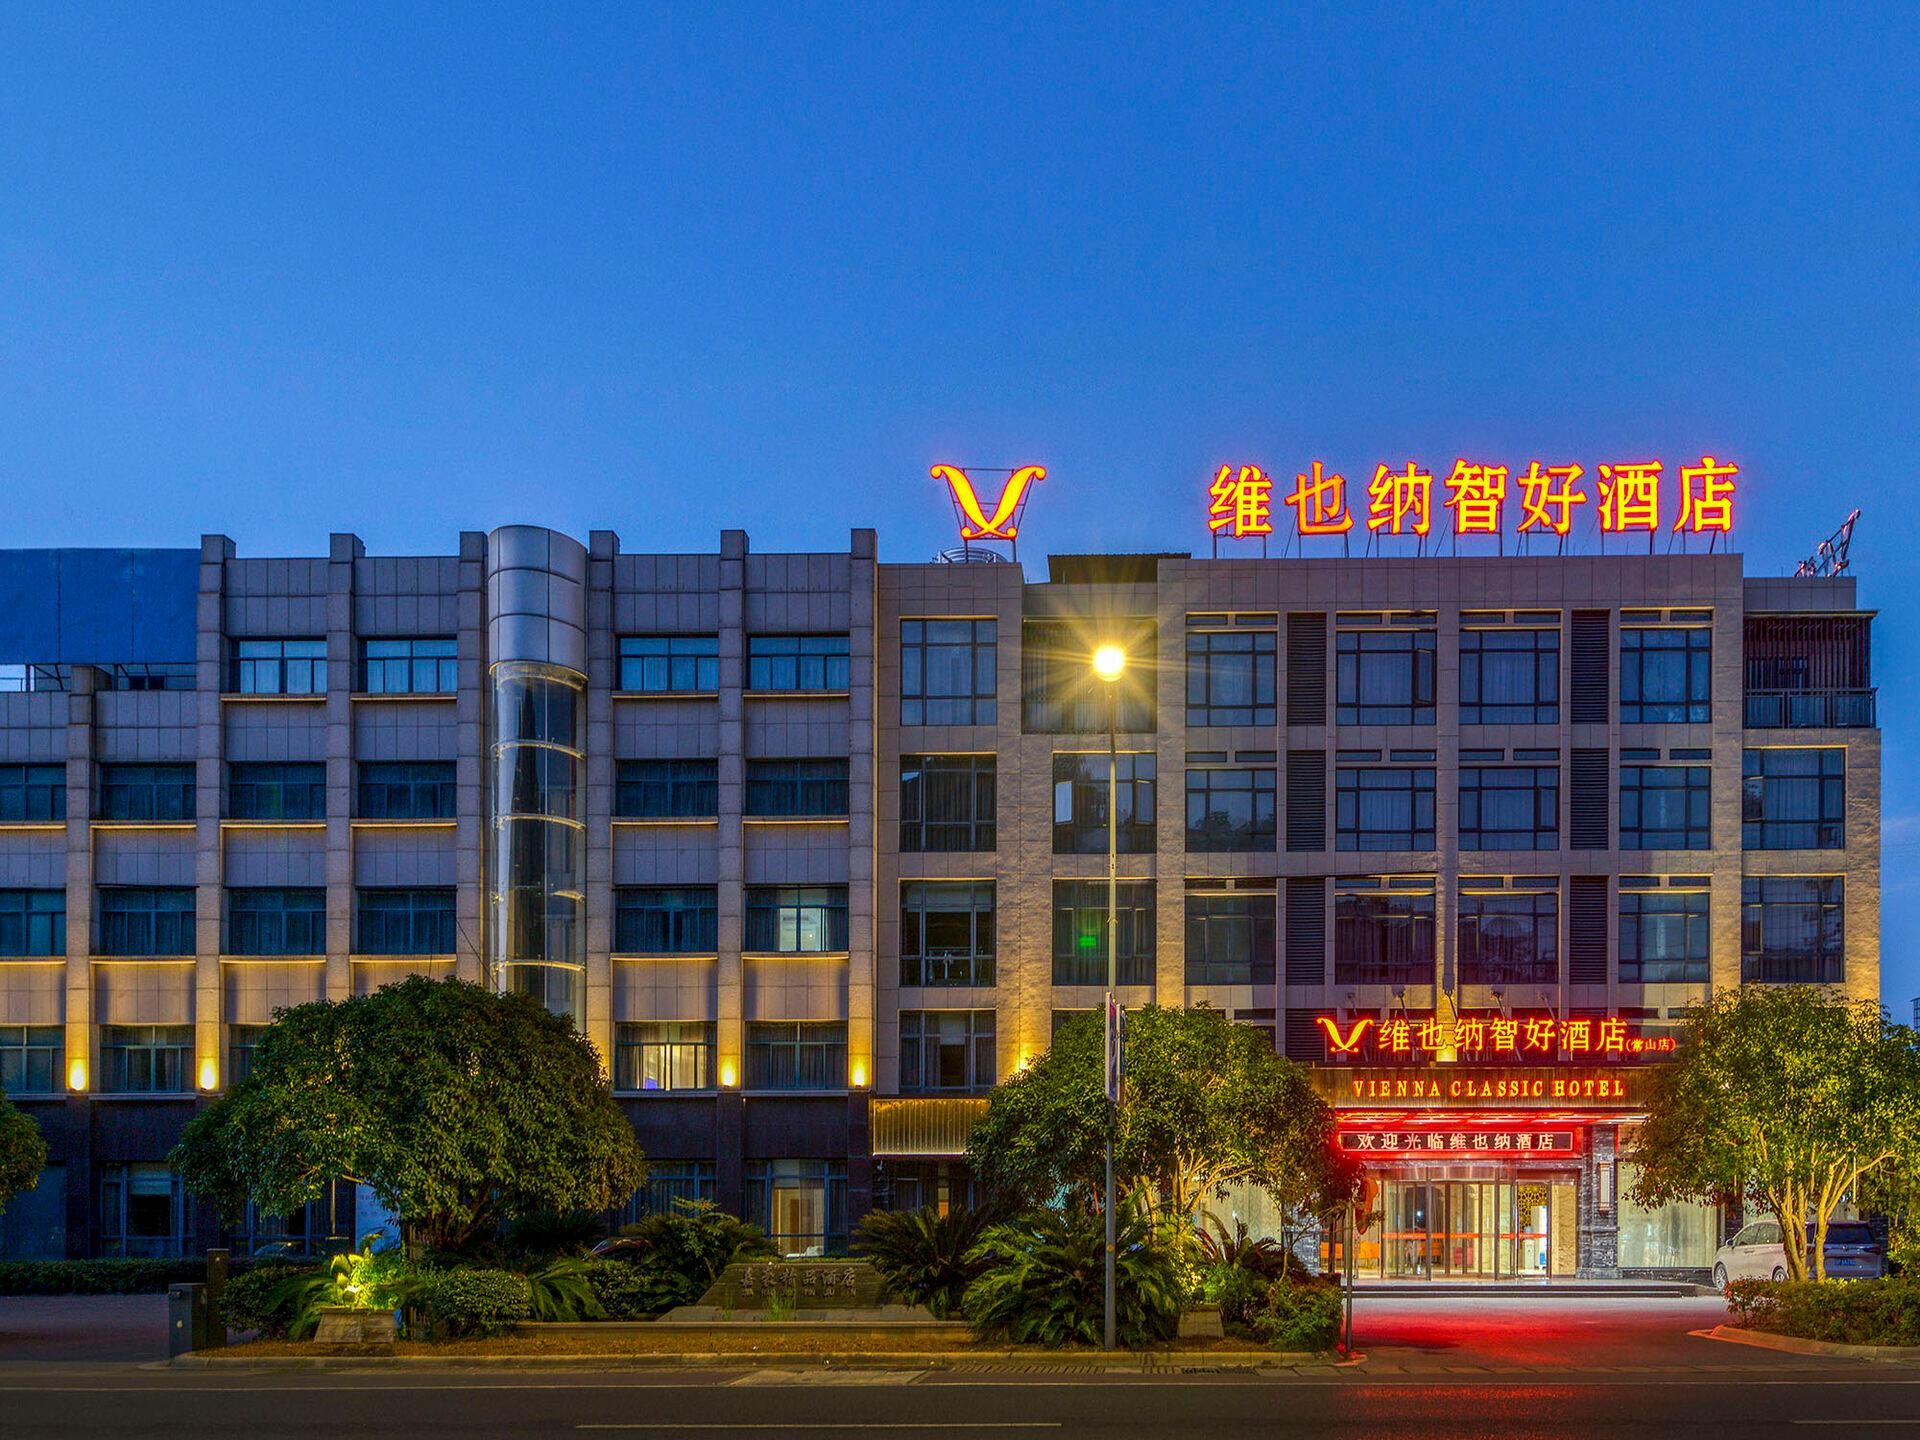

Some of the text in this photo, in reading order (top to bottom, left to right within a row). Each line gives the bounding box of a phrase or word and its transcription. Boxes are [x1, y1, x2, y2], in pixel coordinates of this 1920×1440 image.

[1208, 457, 1739, 536] 维也纳智好酒店
[1378, 1017, 1629, 1053] 维也纳智好酒店
[1353, 1079, 1625, 1098] VIENNA CLASSIC HOTEL
[1356, 1132, 1556, 1151] 欢迎光临维也纳酒店
